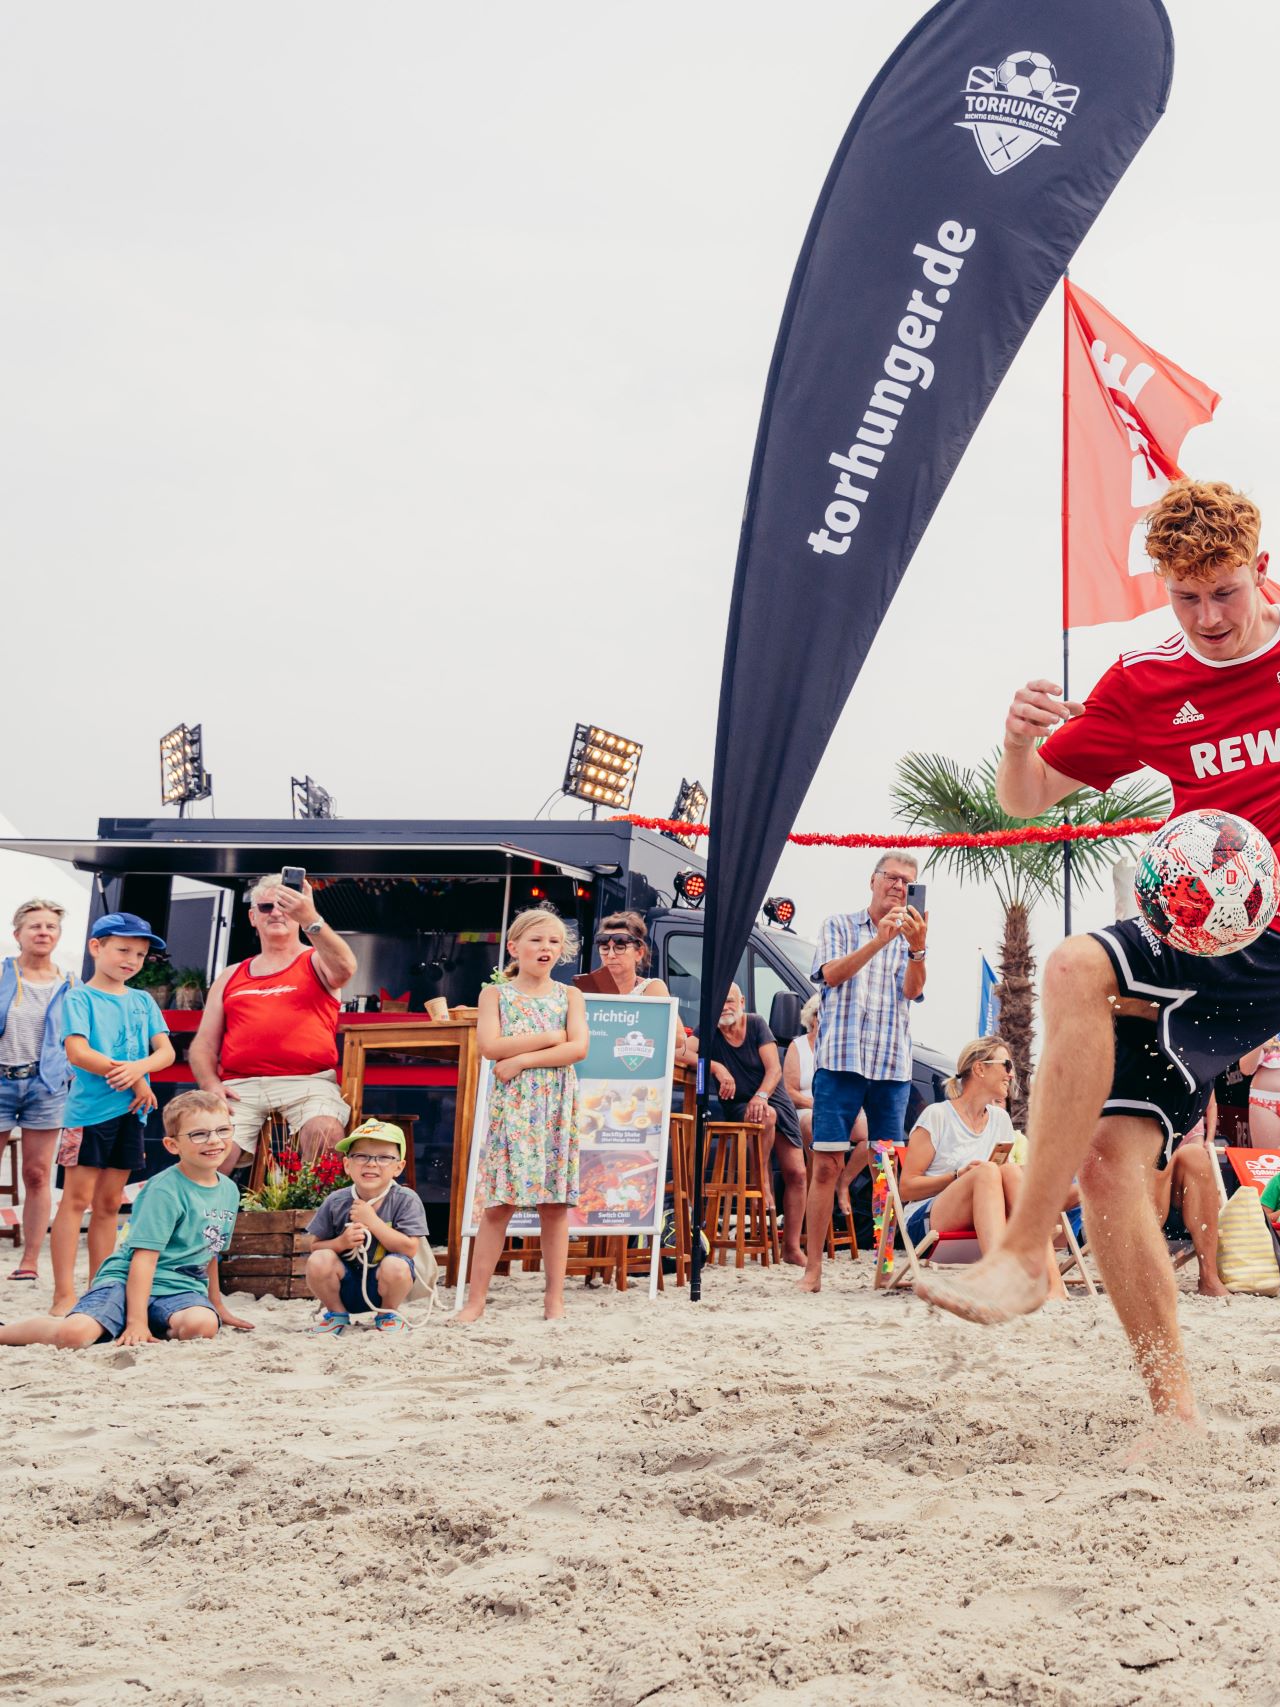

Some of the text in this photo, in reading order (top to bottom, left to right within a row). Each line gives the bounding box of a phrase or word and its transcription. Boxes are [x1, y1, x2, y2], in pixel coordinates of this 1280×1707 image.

[965, 96, 1067, 132] TORHUNGER
[807, 220, 976, 555] torhunger.de
[1172, 713, 1204, 725] adidas
[593, 1010, 640, 1026] richtig!
